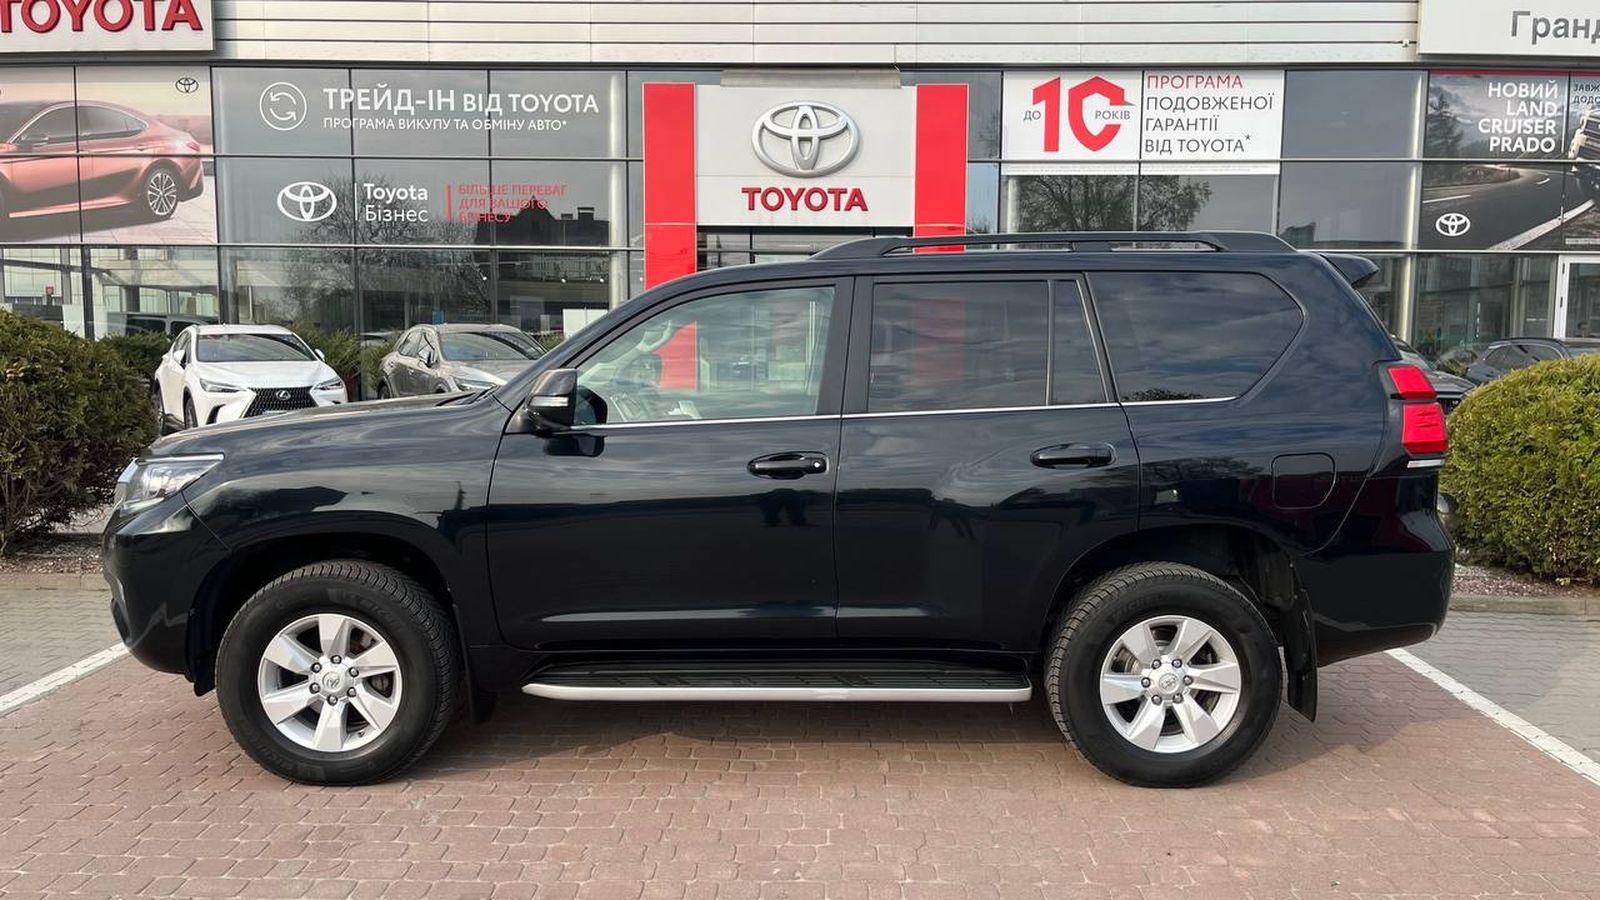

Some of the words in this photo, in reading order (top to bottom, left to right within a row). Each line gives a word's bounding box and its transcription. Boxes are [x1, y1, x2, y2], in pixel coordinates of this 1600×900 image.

[0, 0, 204, 33] TOYOTA
[1146, 75, 1243, 89] ПРОГРАМА
[1488, 80, 1558, 98] НОВИЙ
[323, 83, 455, 115] ТРЕЙД-ІН
[463, 93, 503, 116] ВІД
[508, 94, 599, 113] TOYOTA
[1146, 92, 1275, 113] ПОДОВЖЕНОЇ
[1023, 109, 1042, 122] ДО
[1094, 110, 1131, 121] РОКІВ
[1506, 101, 1558, 116] LAND
[323, 117, 395, 129] ПРОГРАМА
[399, 118, 451, 130] ВИКУПУ
[453, 119, 469, 130] ТА
[472, 119, 525, 131] ОБМІНУ
[1145, 114, 1220, 131] ГАРАНТІЇ
[1478, 118, 1557, 134] CRUISER
[1145, 139, 1172, 155] ВІД
[1489, 136, 1556, 152] PRADO
[363, 183, 428, 204] Toyota
[741, 187, 868, 211] TOYOTA
[365, 204, 429, 222] Бізнес
